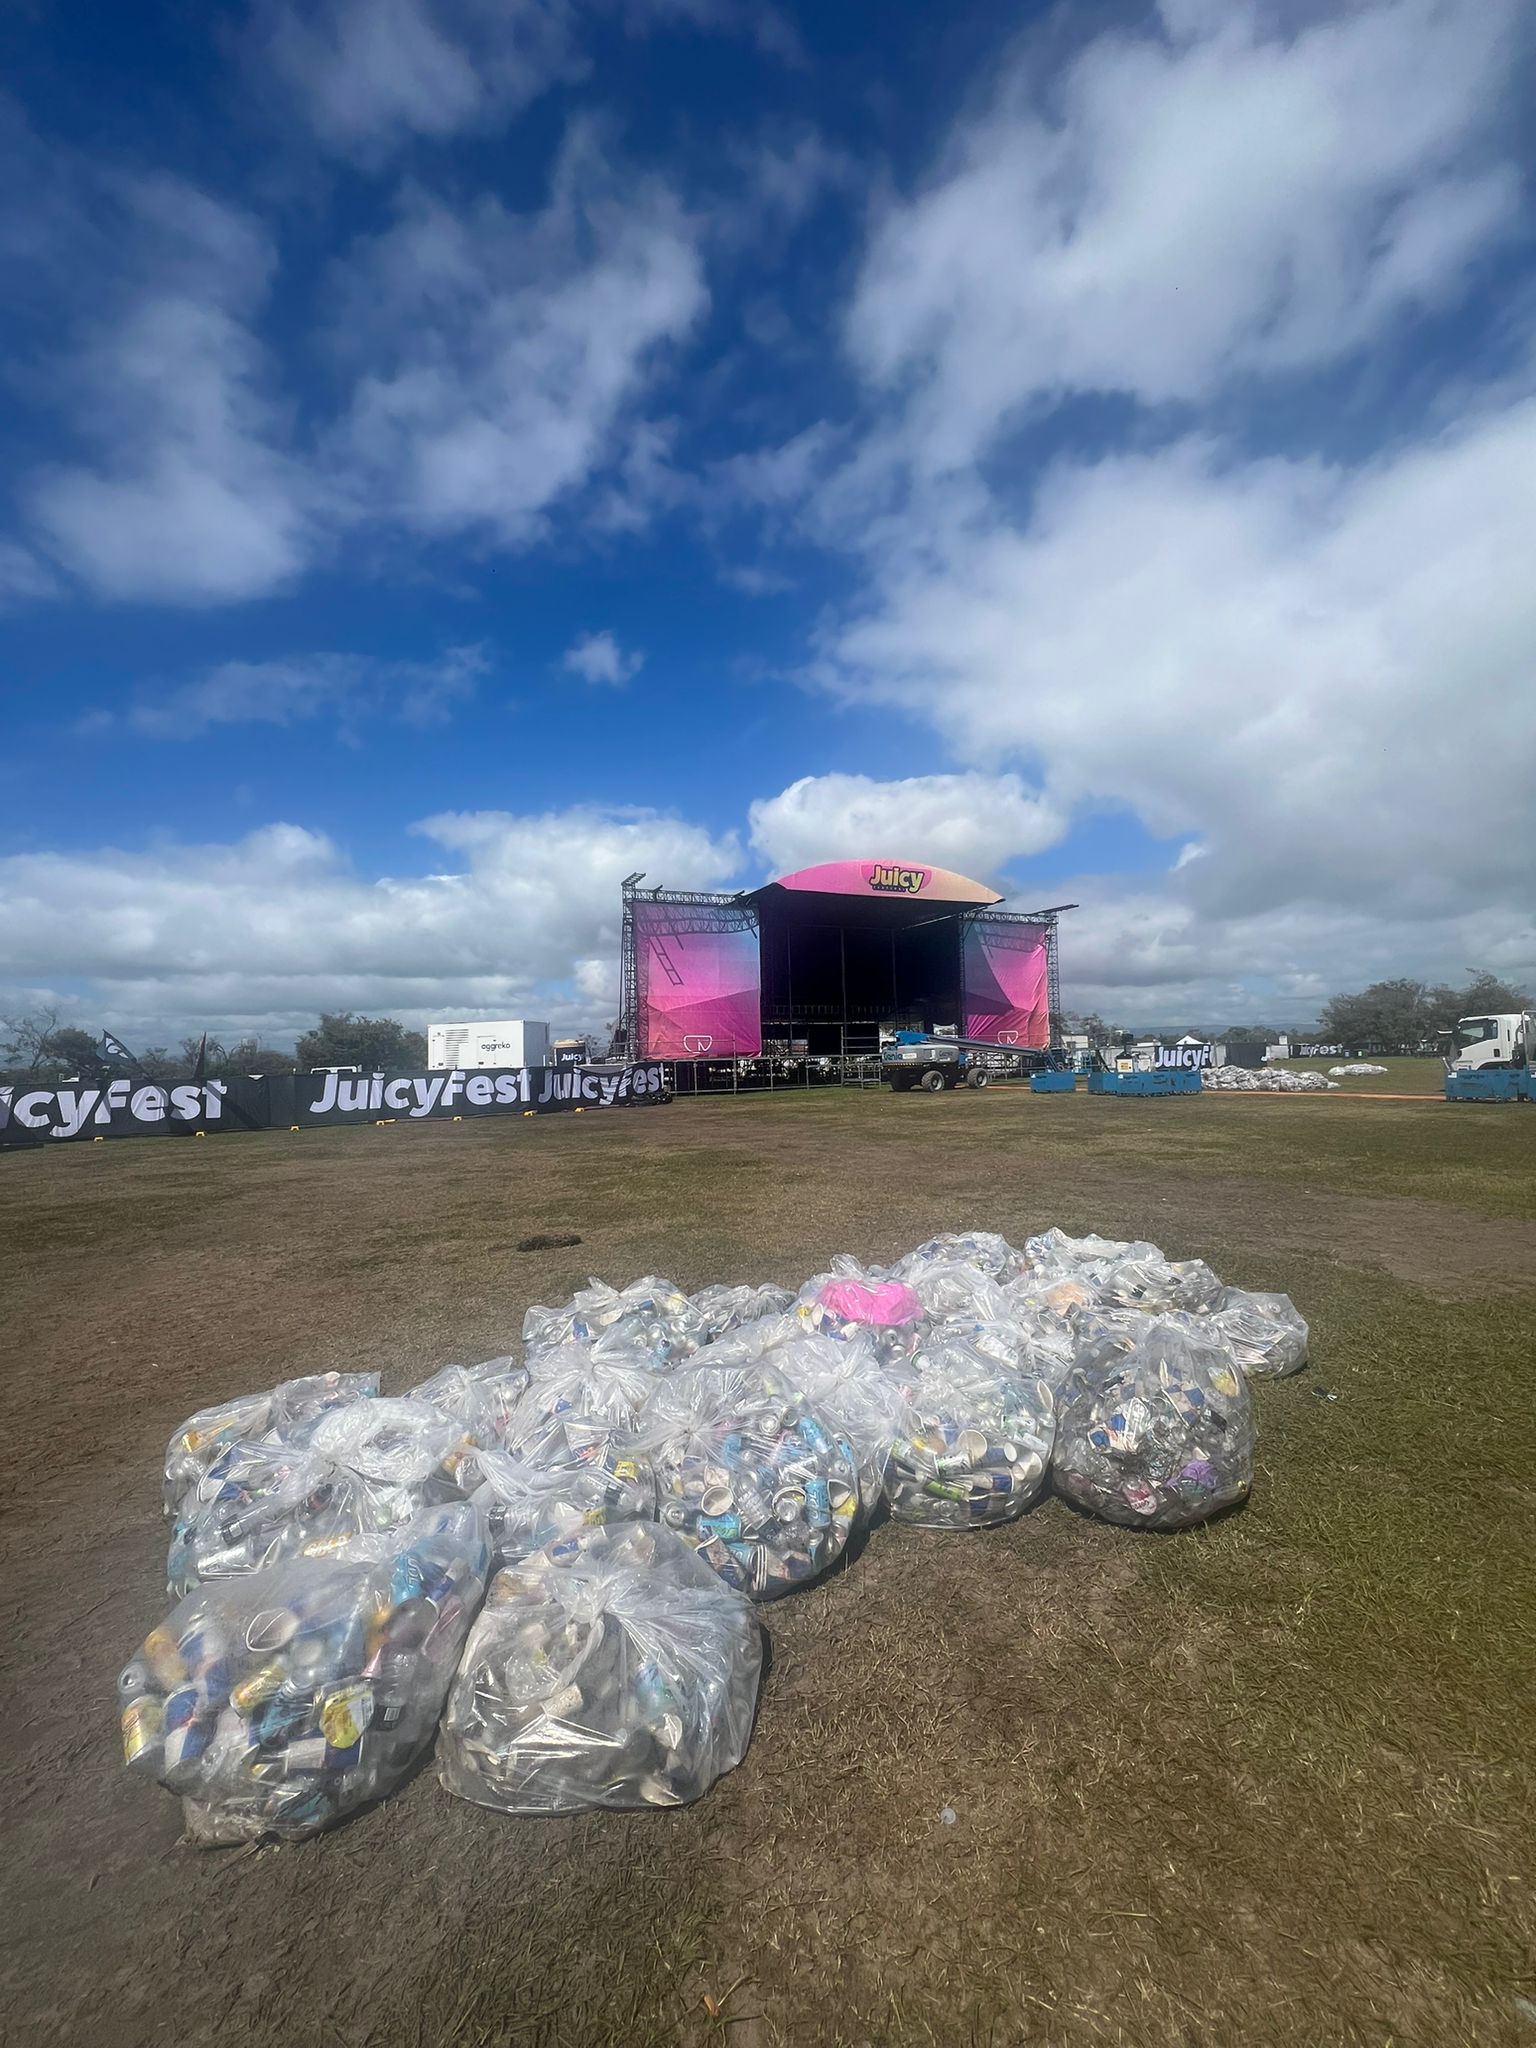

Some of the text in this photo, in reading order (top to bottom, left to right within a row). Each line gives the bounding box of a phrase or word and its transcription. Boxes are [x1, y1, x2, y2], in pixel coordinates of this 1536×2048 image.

[869, 865, 924, 893] Juicy
[481, 1042, 511, 1052] aggreko
[561, 1053, 582, 1061] Juicy
[309, 1069, 532, 1117] JuicyFest
[538, 1062, 665, 1105] JuicyFest
